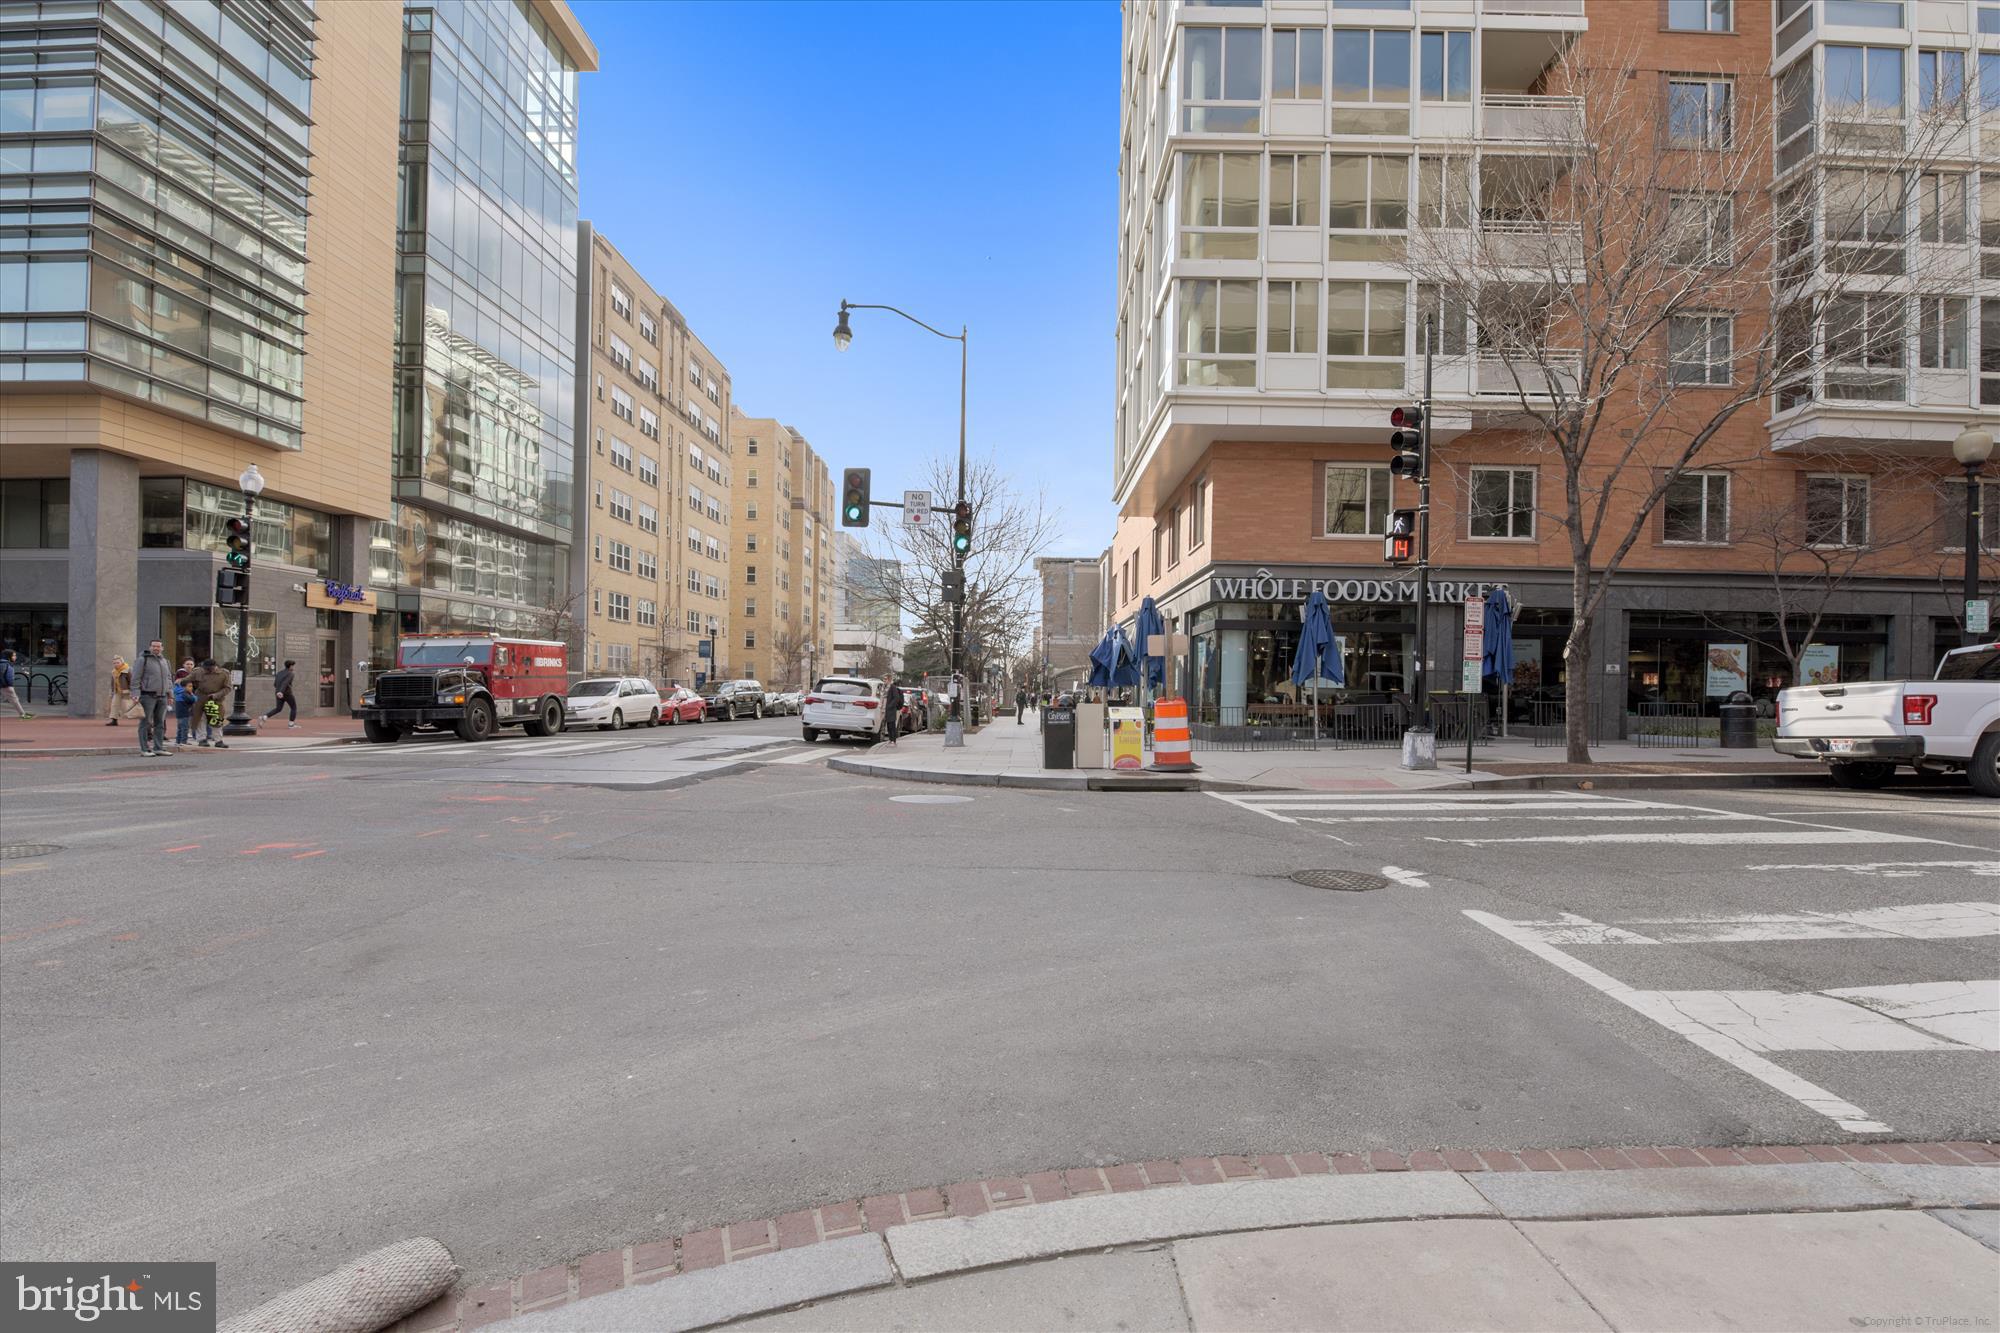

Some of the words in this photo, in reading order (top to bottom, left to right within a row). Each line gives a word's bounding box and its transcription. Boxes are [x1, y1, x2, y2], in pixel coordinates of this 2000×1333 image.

[911, 493, 924, 501] NO
[1394, 540, 1408, 558] 14
[1310, 580, 1394, 602] FOODS
